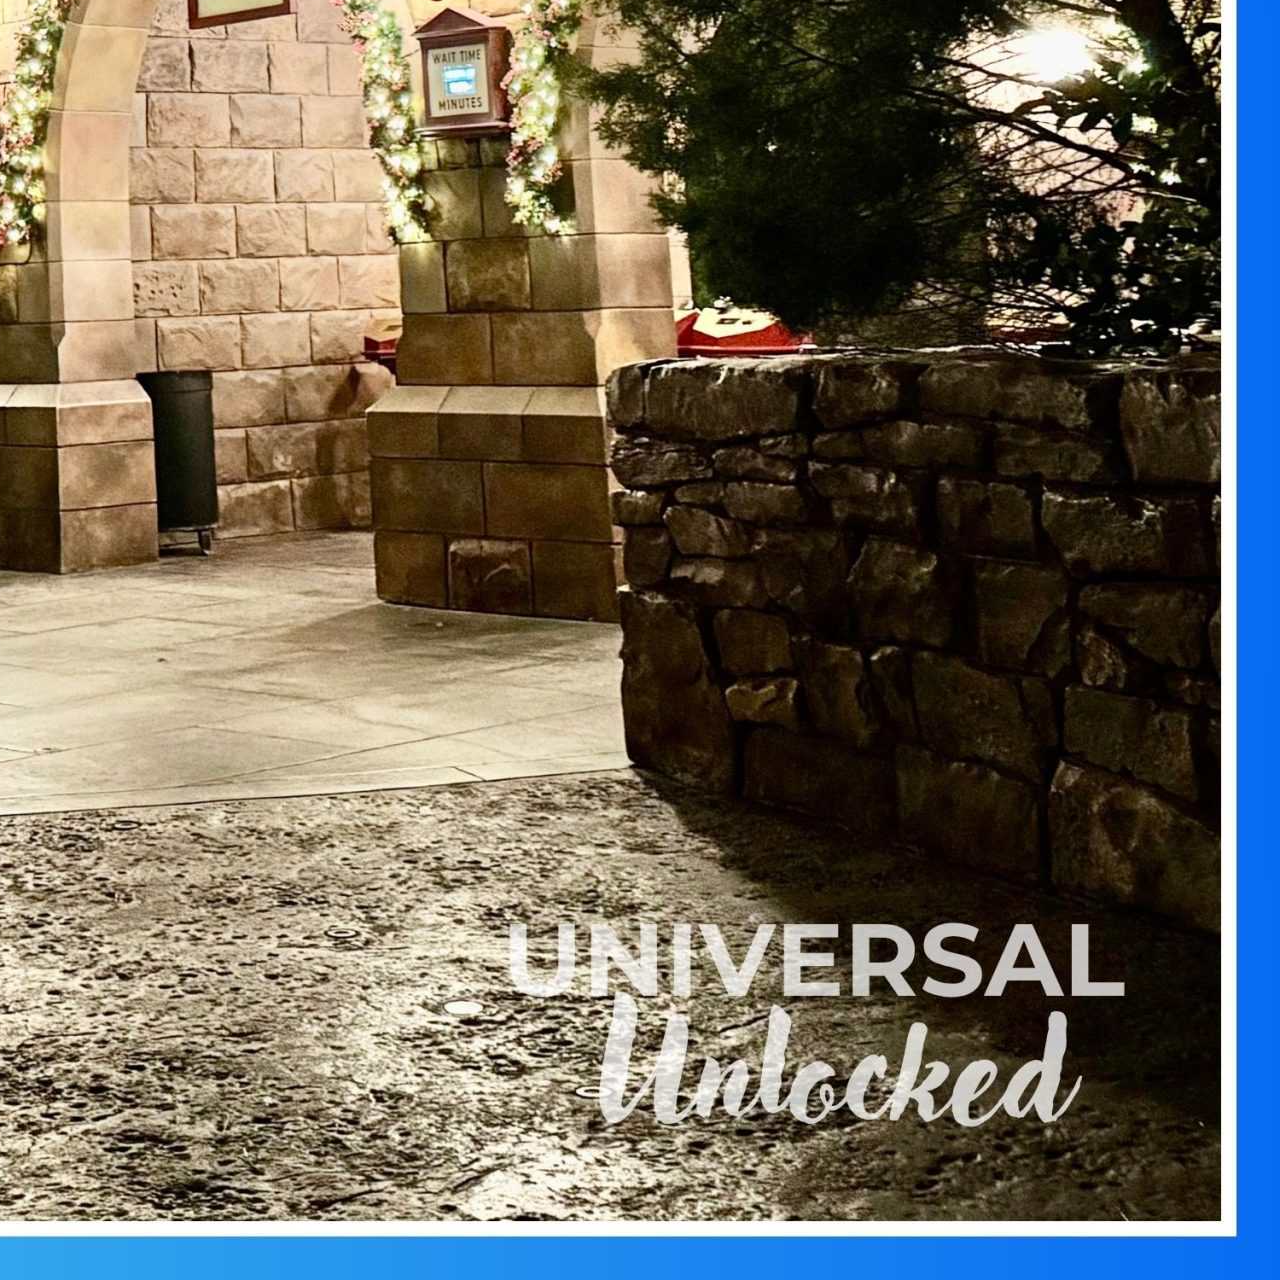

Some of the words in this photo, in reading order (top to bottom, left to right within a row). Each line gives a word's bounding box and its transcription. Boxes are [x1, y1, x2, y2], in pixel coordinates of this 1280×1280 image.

[432, 51, 456, 64] WAIT
[460, 48, 482, 62] TIME
[437, 96, 483, 111] MINUTES
